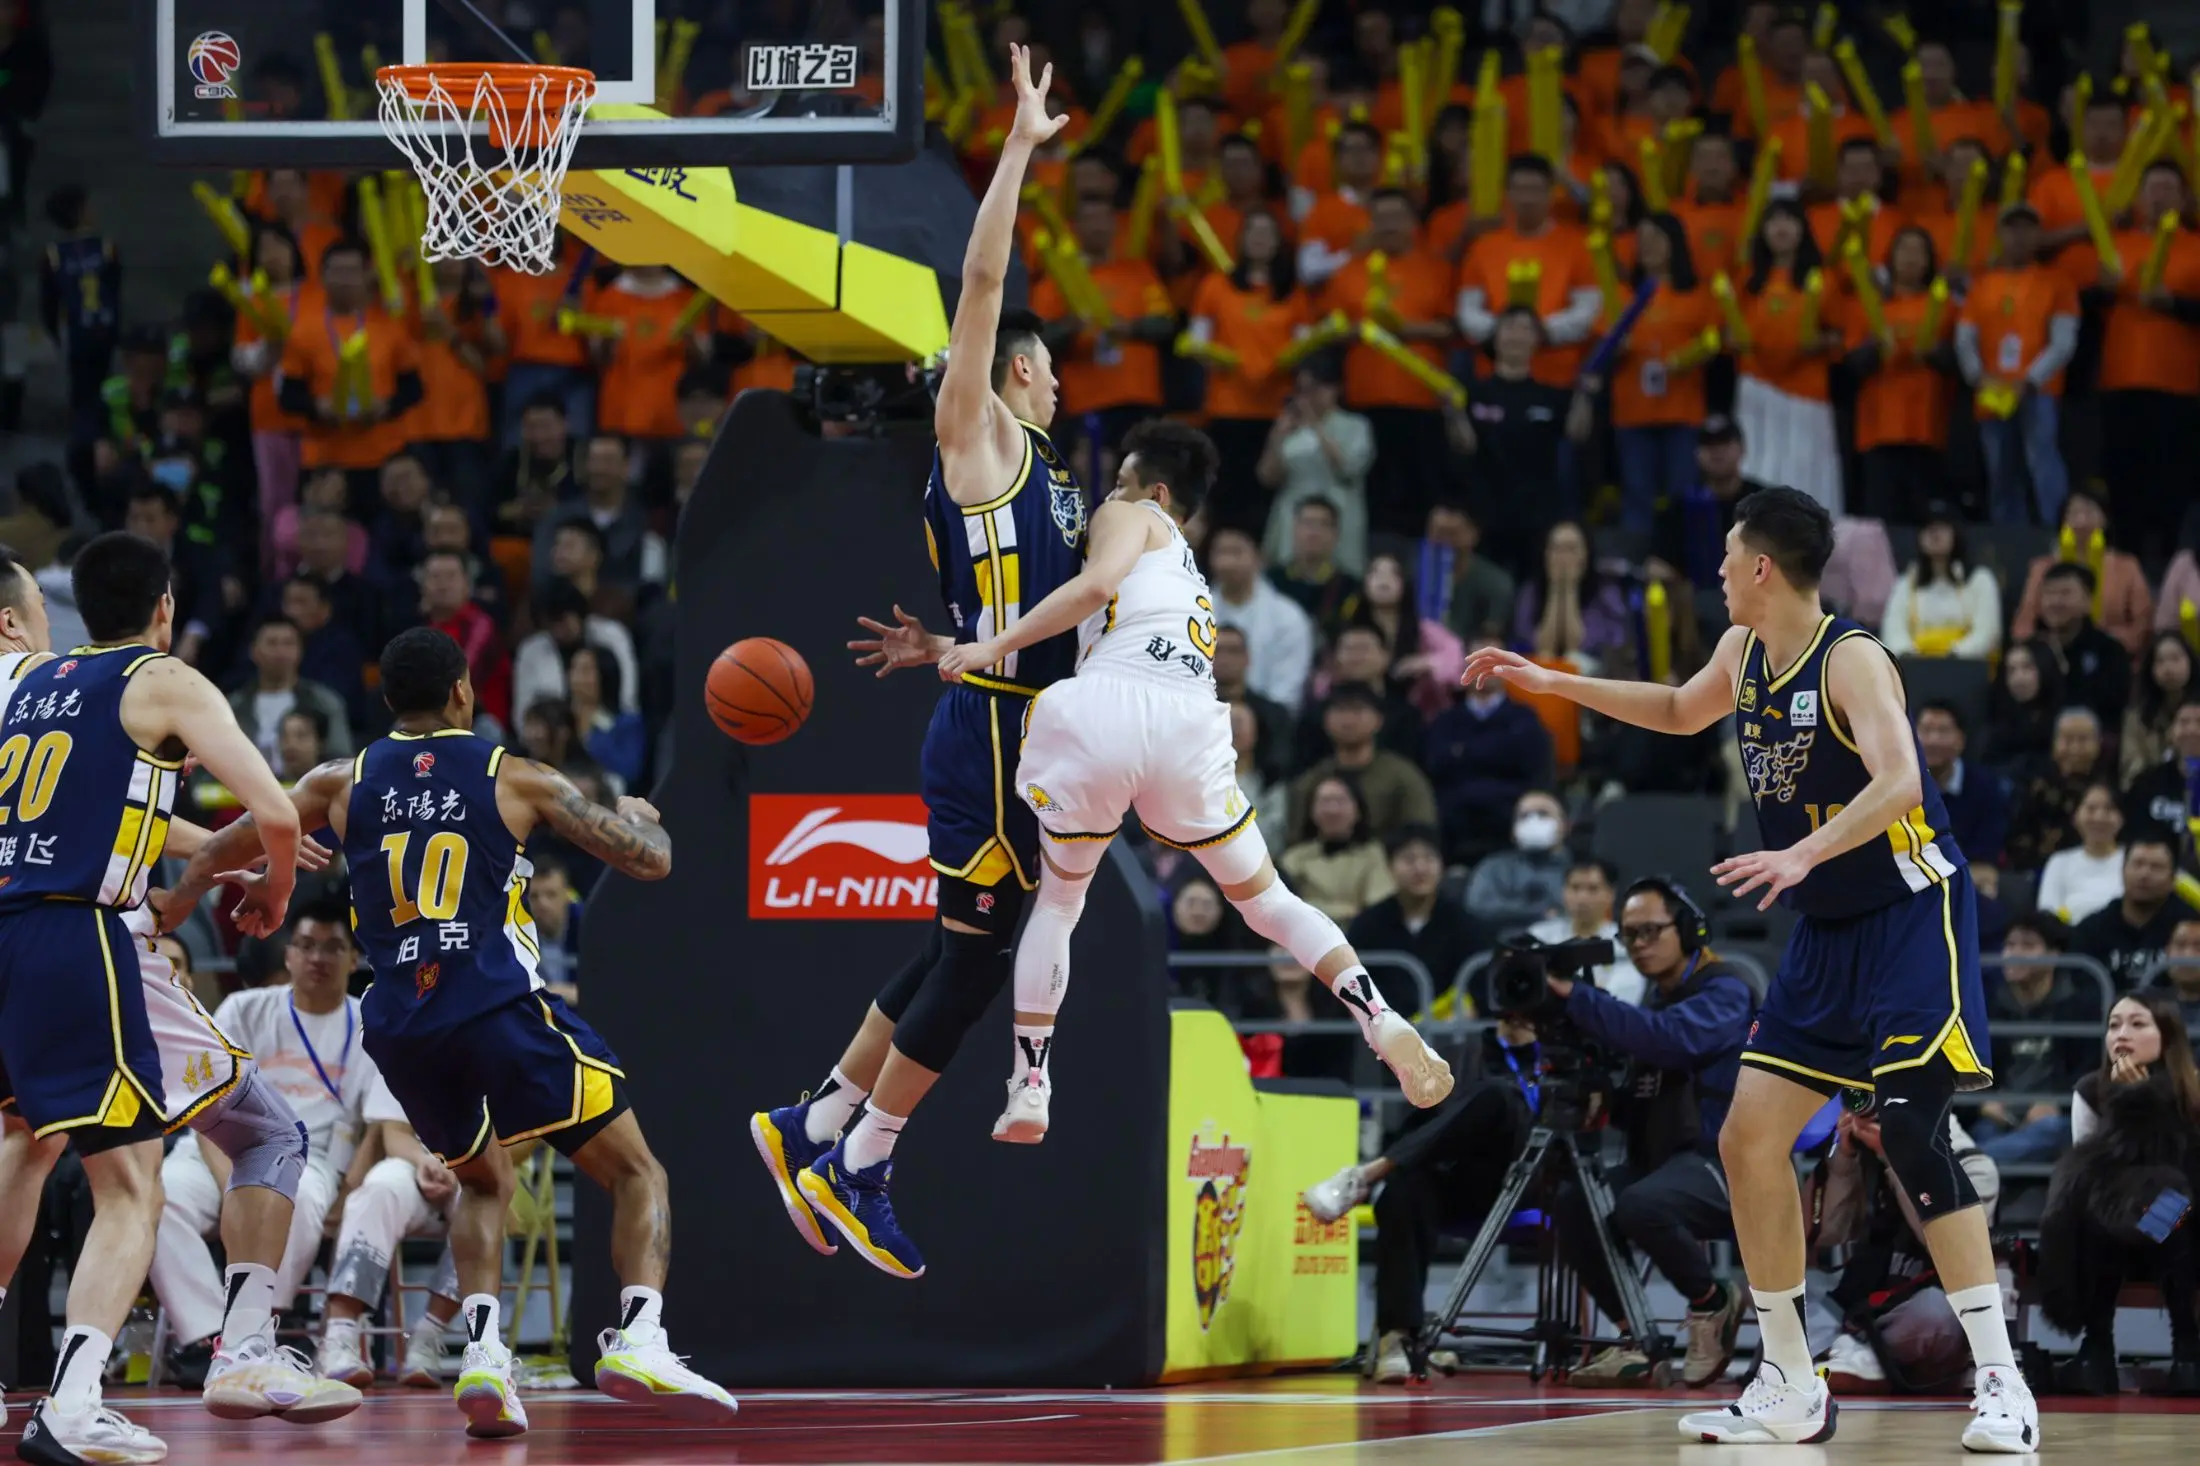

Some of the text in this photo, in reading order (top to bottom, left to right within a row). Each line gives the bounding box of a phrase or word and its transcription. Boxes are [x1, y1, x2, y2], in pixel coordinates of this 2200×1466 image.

[748, 44, 857, 89] 以城之名
[195, 85, 237, 98] CBA
[0, 730, 73, 825] 20
[380, 831, 470, 929] 10
[396, 921, 470, 966] 伯克
